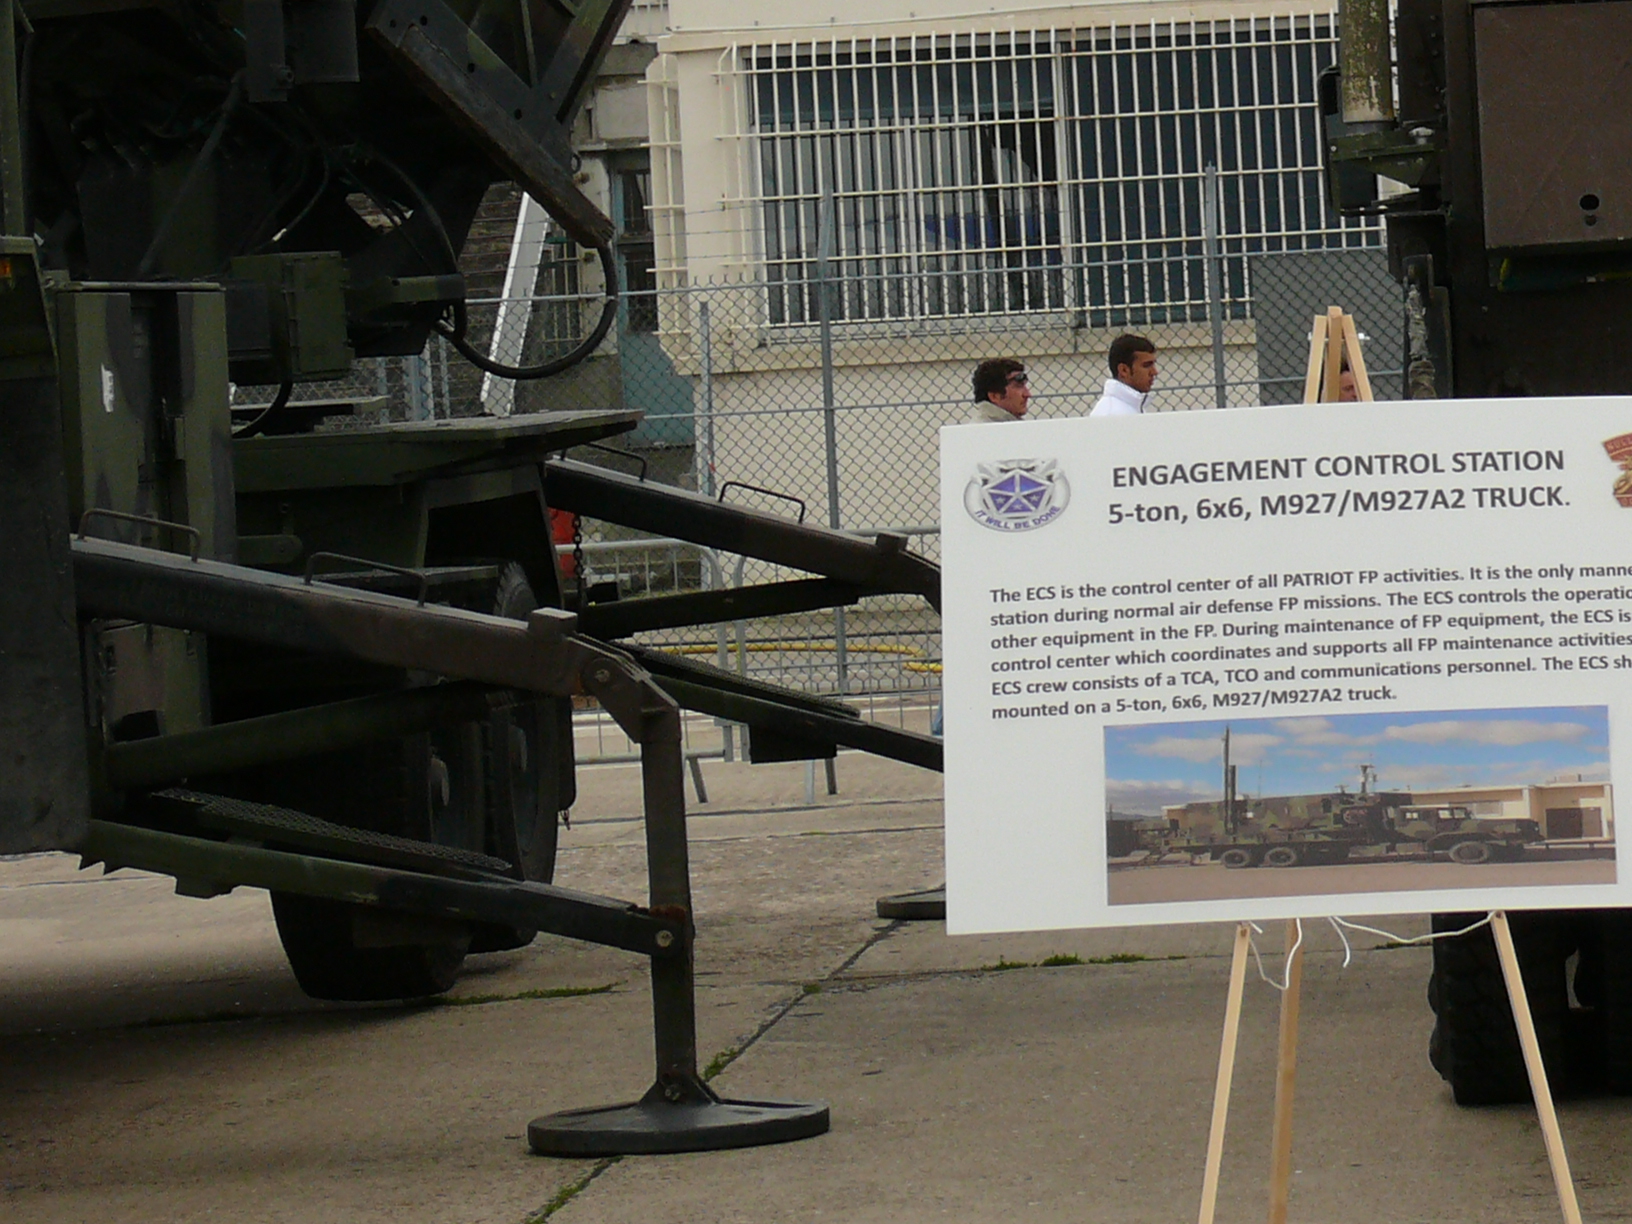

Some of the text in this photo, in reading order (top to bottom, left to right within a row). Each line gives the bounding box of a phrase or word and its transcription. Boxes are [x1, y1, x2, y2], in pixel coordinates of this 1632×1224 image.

[1113, 450, 1564, 488] ENGAGEMENT CONTROL STATION
[975, 506, 1060, 529] IT WILL BE DONE
[1109, 486, 1570, 524] 5-ton, 6x6, M927/M927A2 TRUCK.
[989, 588, 1021, 603] The
[1026, 586, 1056, 601] ECS
[1061, 585, 1074, 599] is
[1078, 583, 1107, 598] the
[1112, 579, 1172, 596] control
[1177, 579, 1231, 592] center
[1236, 575, 1254, 589] of
[1258, 574, 1278, 588] all
[1283, 571, 1354, 587] PATRIOT
[1359, 570, 1378, 584] FP
[1383, 567, 1464, 583] activities.
[1470, 567, 1482, 580] It
[1487, 566, 1500, 580] is
[1504, 565, 1533, 579] the
[1538, 563, 1574, 581] only
[990, 610, 1048, 626] station
[1054, 607, 1109, 623] during
[1114, 602, 1174, 619] normal
[1179, 601, 1202, 615] air
[1207, 599, 1273, 614] defense
[1279, 597, 1299, 611] FP
[1304, 594, 1381, 610] missions.
[1386, 592, 1418, 606] The
[1424, 591, 1454, 605] ECS
[1458, 588, 1527, 604] controls
[1531, 587, 1559, 602] the
[991, 634, 1038, 649] other
[1042, 629, 1134, 649] equipment
[1140, 627, 1156, 641] in
[1161, 625, 1189, 640] the
[1195, 624, 1217, 638] FP.
[1222, 621, 1279, 638] During
[1284, 619, 1394, 634] maintenance
[1400, 614, 1418, 629] of
[1423, 614, 1442, 628] FP
[1447, 613, 1545, 630] equipment,
[1550, 610, 1578, 624] the
[1584, 609, 1614, 623] ECS
[1618, 609, 1631, 622] is
[991, 655, 1051, 672] control
[1056, 655, 1111, 669] center
[1115, 649, 1166, 665] which
[1171, 646, 1271, 662] coordinates
[1276, 642, 1307, 657] and
[1313, 641, 1387, 658] supports
[1393, 638, 1413, 652] all
[1418, 638, 1437, 651] FP
[1443, 636, 1553, 650] maintenance
[992, 681, 1022, 696] ECS
[1026, 681, 1068, 694] crew
[1072, 675, 1139, 691] consists
[1144, 672, 1162, 687] of
[1167, 676, 1176, 686] a
[1180, 671, 1219, 686] TCA,
[1224, 668, 1259, 683] TCO
[1264, 666, 1295, 681] and
[1301, 662, 1442, 679] communications
[1447, 657, 1536, 677] personnel.
[1541, 656, 1573, 671] The
[1579, 656, 1609, 670] ECS
[992, 685, 1397, 719] mounted on a 5-ton, 6x6, M927/M927A2 truck.
